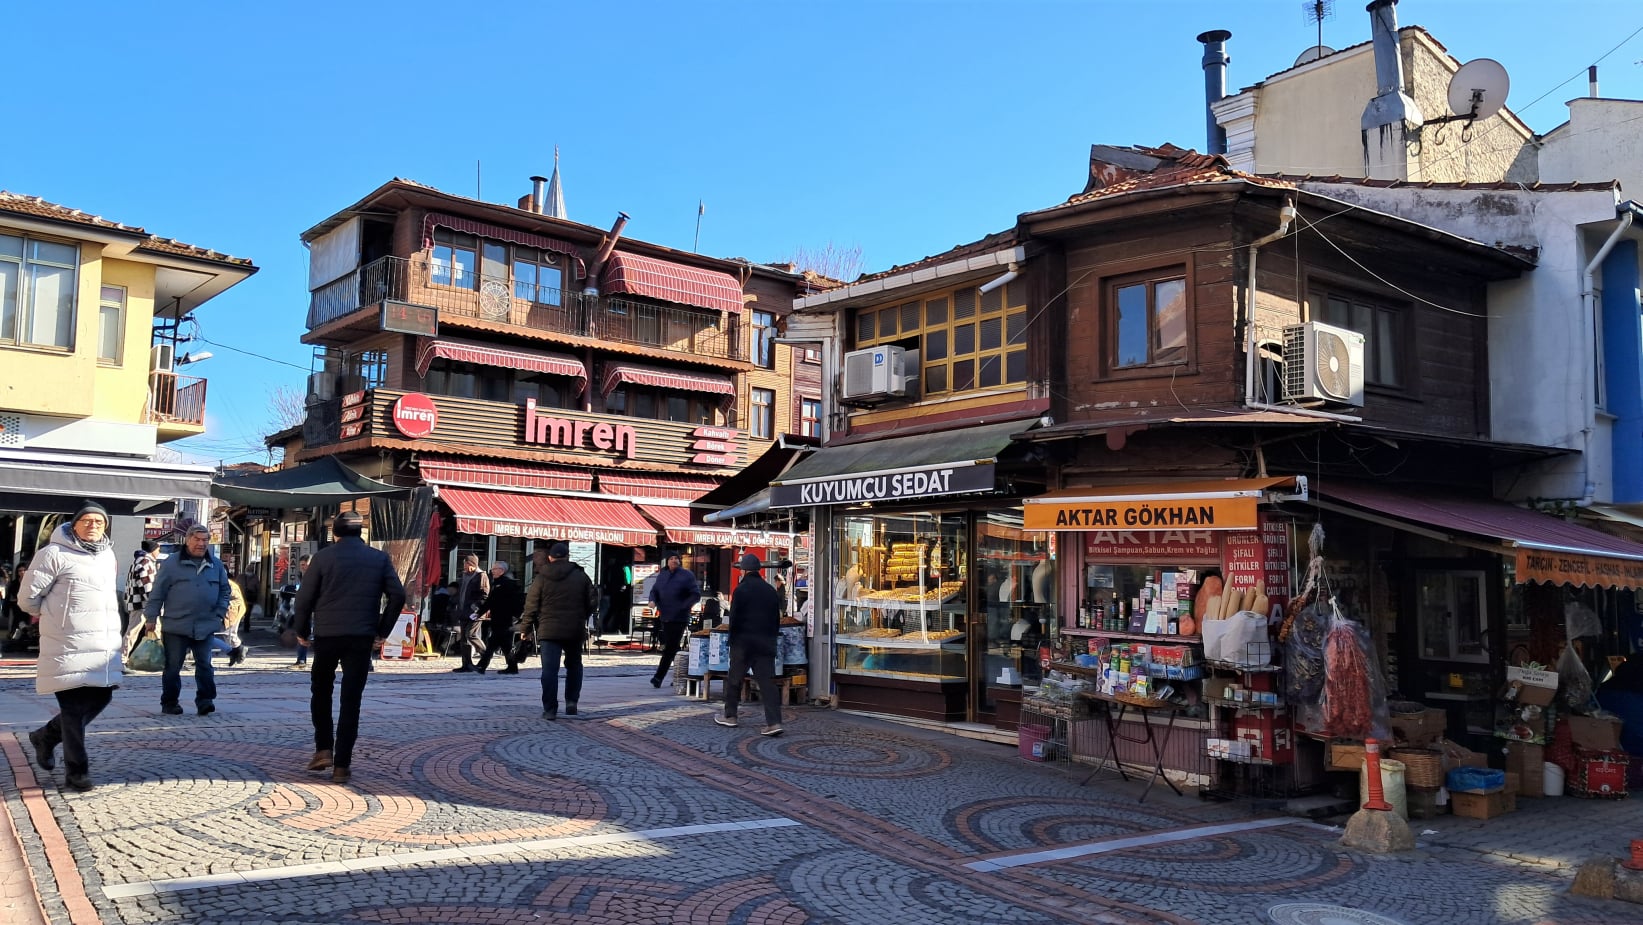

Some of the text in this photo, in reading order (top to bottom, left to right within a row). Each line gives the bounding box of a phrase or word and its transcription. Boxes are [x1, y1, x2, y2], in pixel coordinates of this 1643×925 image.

[703, 428, 730, 438] Kahvaltı
[801, 470, 953, 503] KUYUMCU SEDAT
[1056, 504, 1214, 526] AKTAR GÖKHAN
[523, 524, 559, 539] KAHVALTI
[561, 529, 566, 538] &
[568, 527, 594, 540] DÖNER
[595, 531, 624, 542] SALONU
[1088, 546, 1112, 554] Bitkisel
[1196, 546, 1218, 555] Yağlar
[1233, 547, 1255, 560] ŞİFALI
[1229, 560, 1259, 571] BİTKİLER
[1234, 575, 1255, 584] FORM
